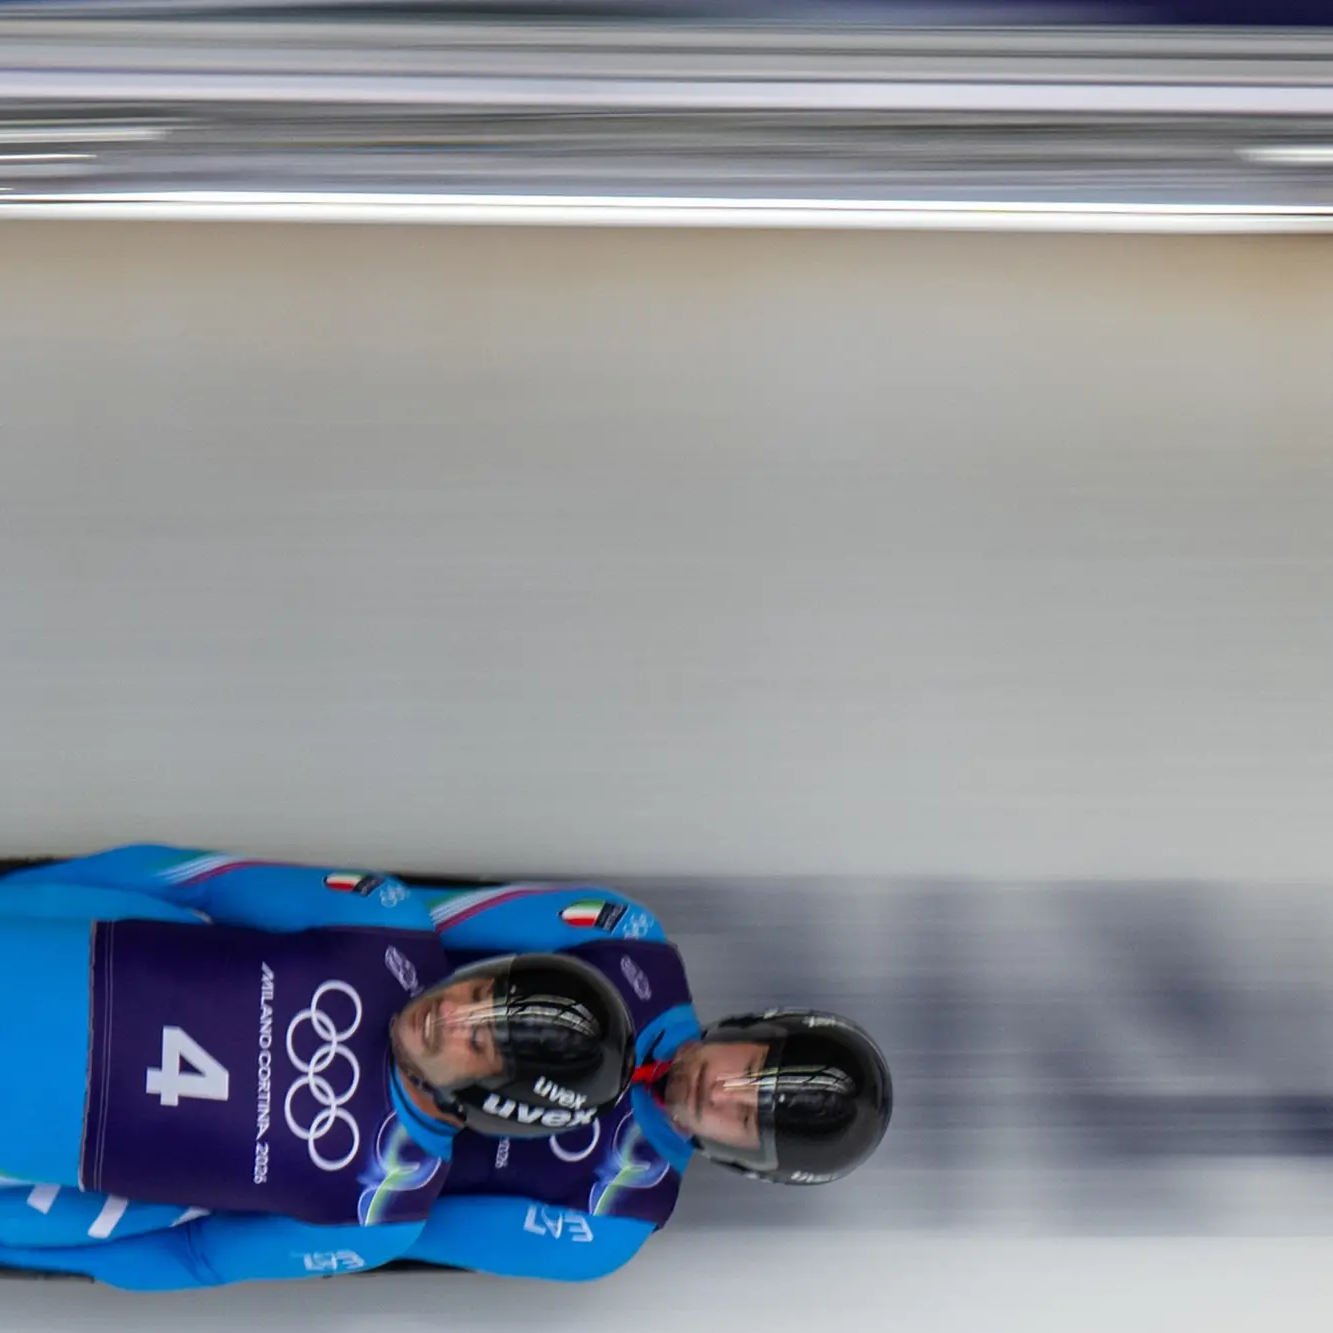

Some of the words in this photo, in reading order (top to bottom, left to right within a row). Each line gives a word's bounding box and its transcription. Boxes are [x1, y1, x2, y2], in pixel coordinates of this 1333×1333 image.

[259, 961, 275, 1049] MILANO
[147, 1026, 229, 1107] 4
[256, 1049, 272, 1140] CORTINA
[482, 1093, 598, 1128] uvex
[533, 1075, 587, 1110] uvex
[253, 1141, 269, 1184] 2026
[523, 1204, 594, 1243] EA7
